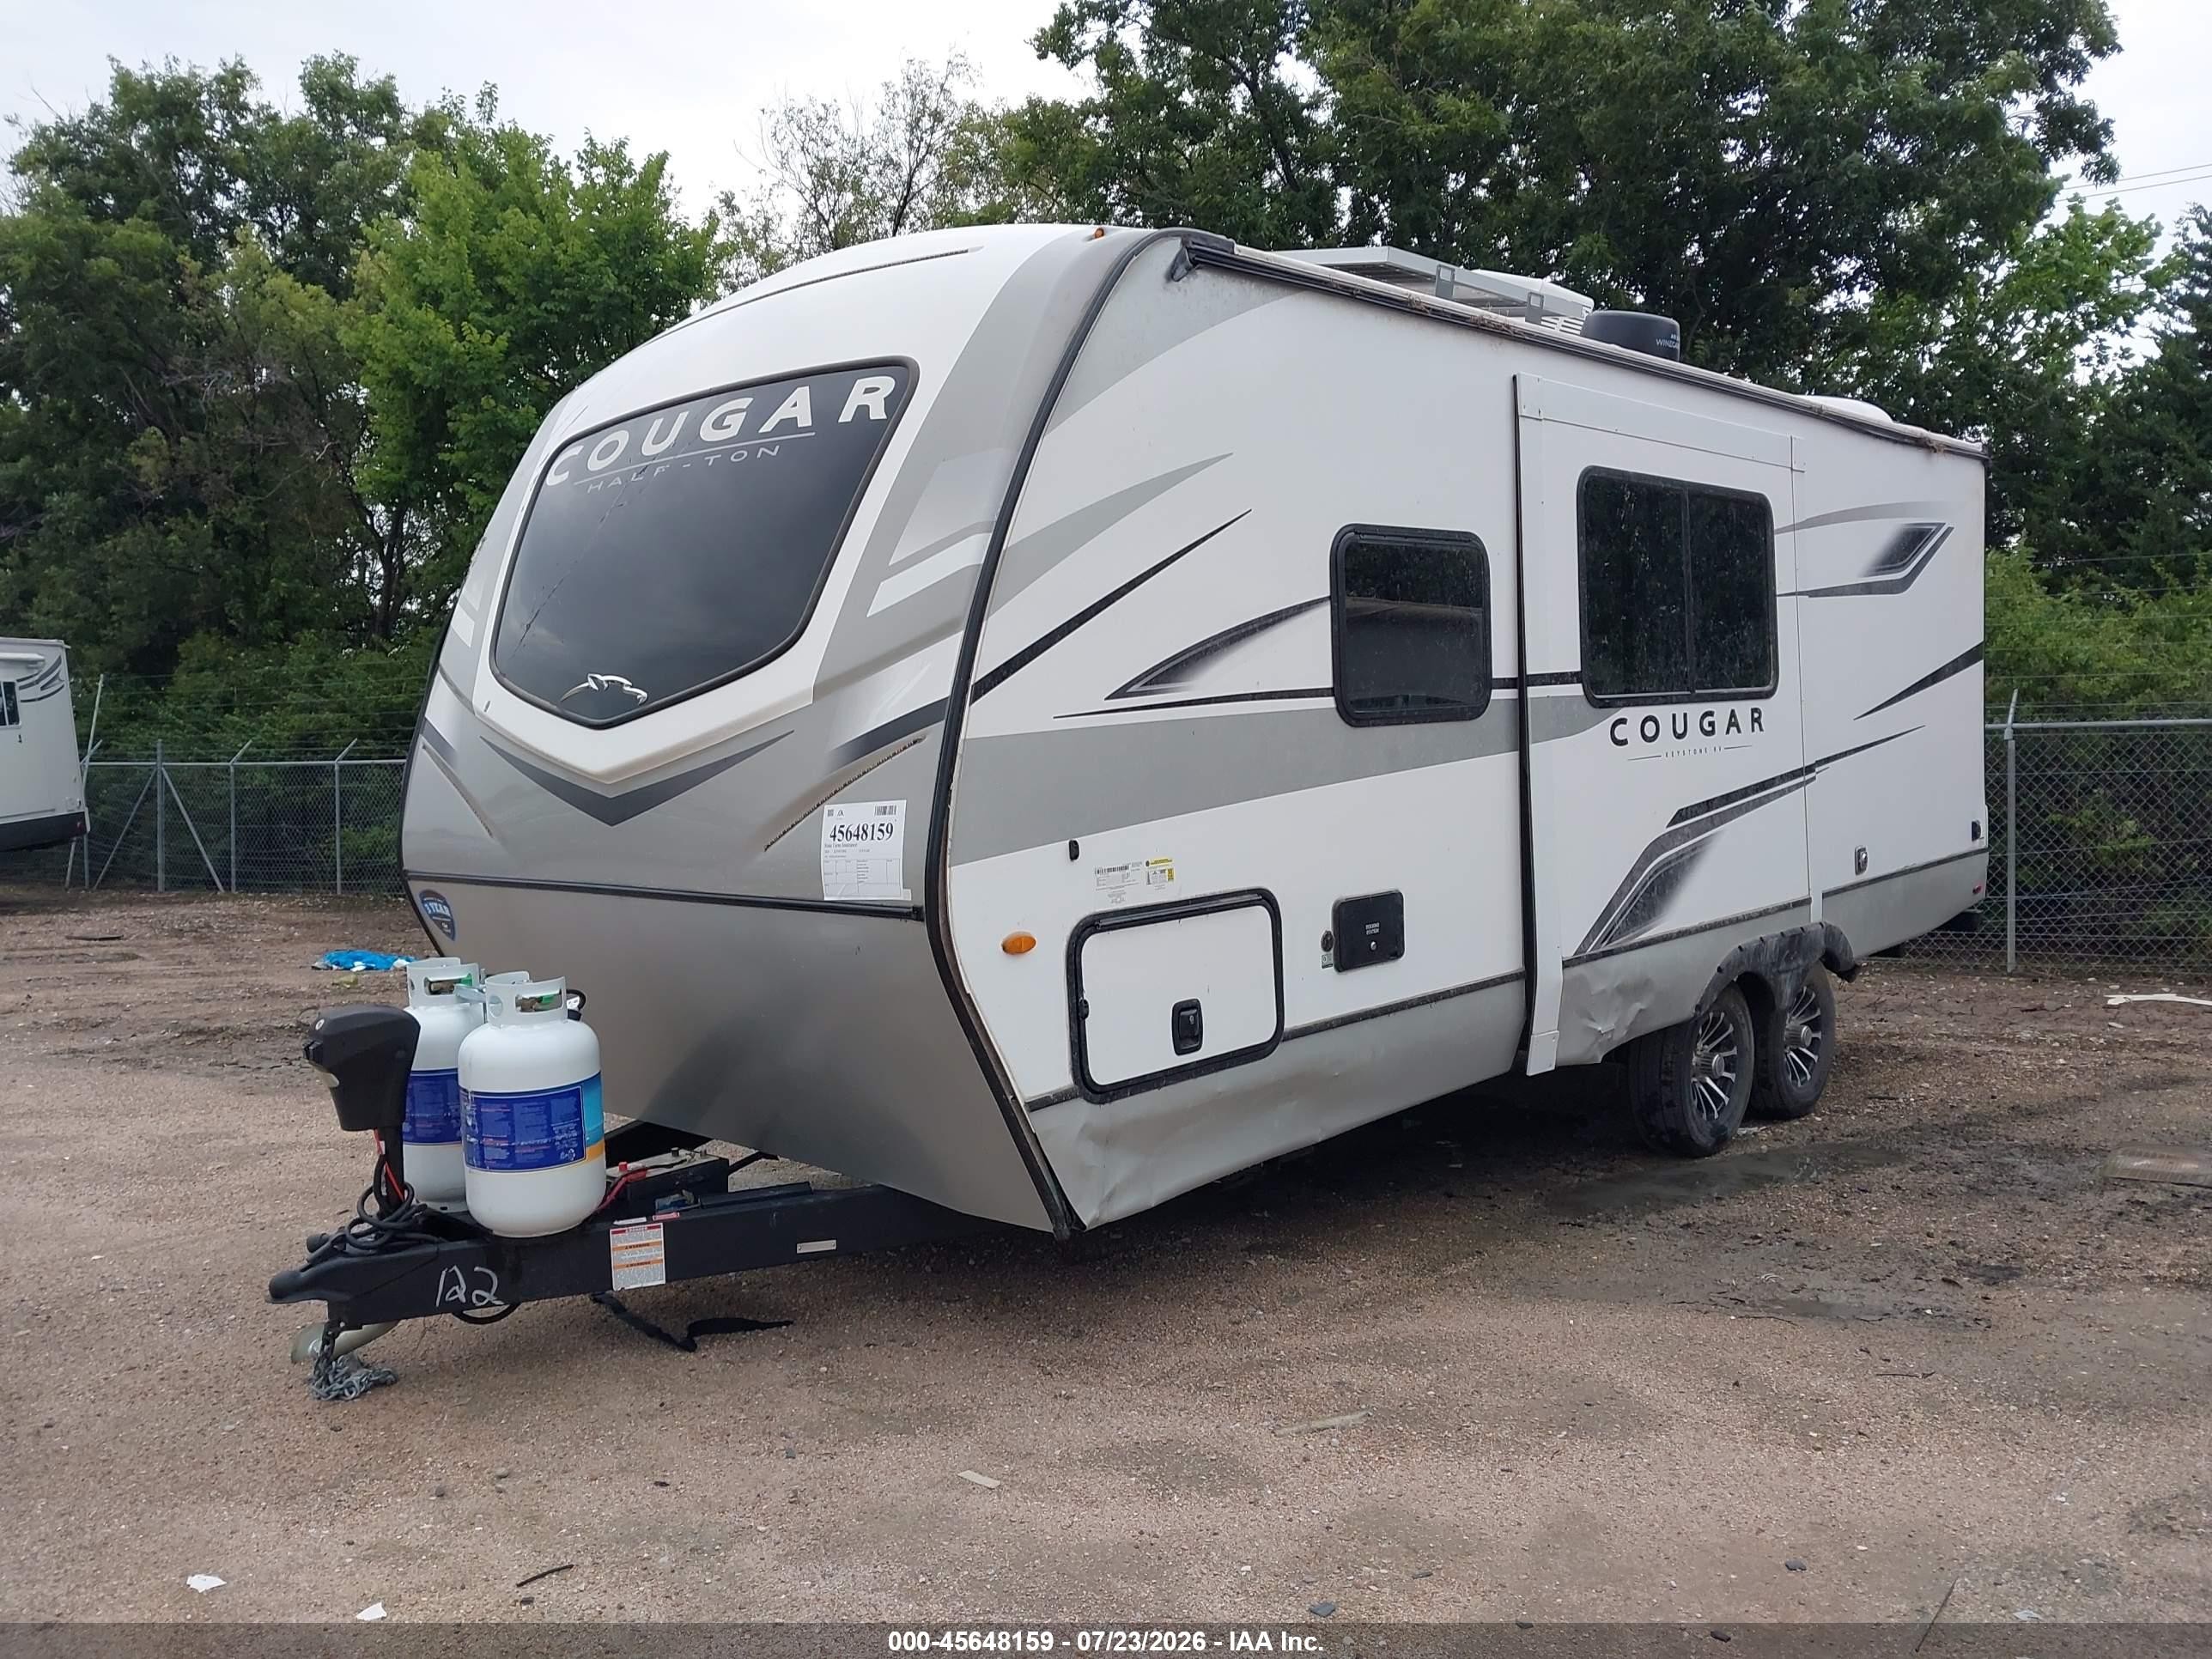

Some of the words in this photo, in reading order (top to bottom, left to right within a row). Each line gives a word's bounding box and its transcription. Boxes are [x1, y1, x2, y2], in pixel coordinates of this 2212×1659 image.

[544, 375, 896, 487] COUGAR
[1609, 707, 1765, 747] COUGAR
[830, 822, 894, 842] 45648159
